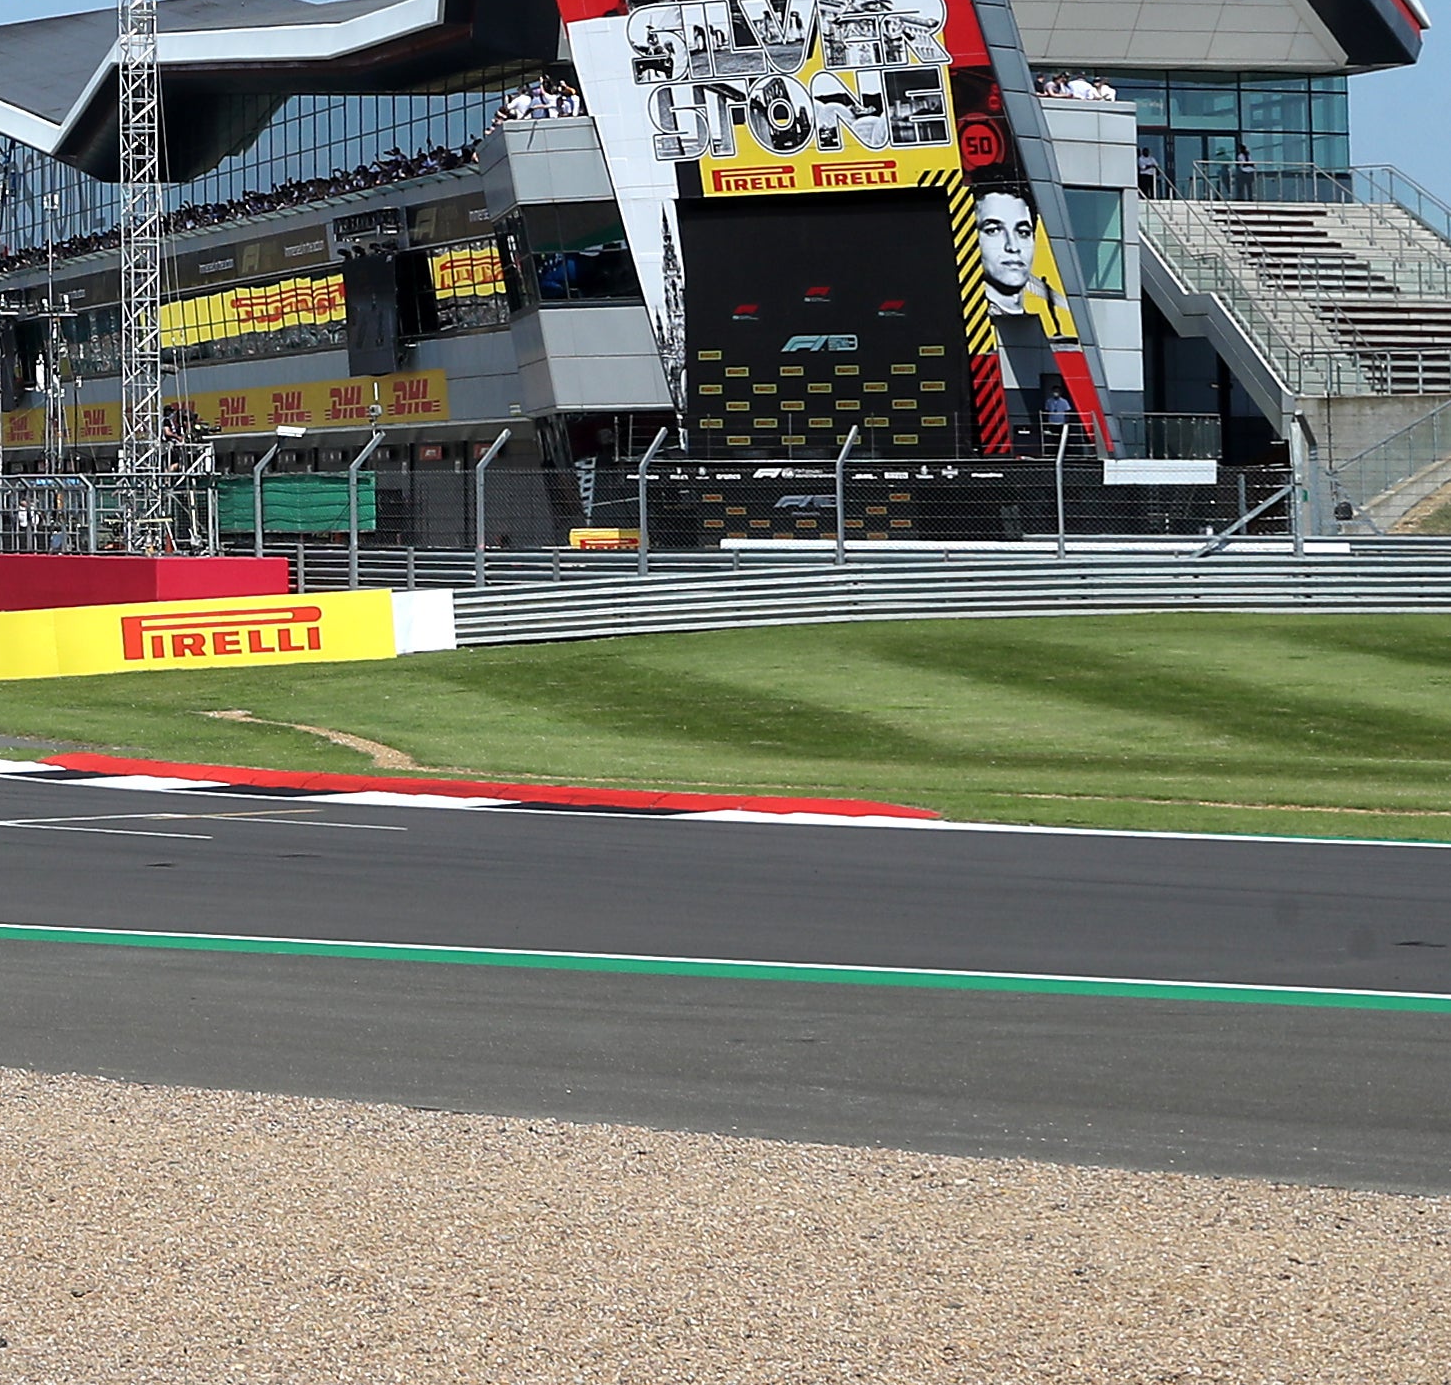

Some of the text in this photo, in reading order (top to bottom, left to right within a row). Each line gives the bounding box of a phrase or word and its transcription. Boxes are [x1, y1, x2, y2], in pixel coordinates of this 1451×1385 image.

[647, 65, 952, 162] STONE
[966, 137, 992, 154] 50
[712, 160, 898, 192] PIRELLI PIRELLI
[219, 396, 249, 426] DHL
[271, 391, 305, 422] DHL
[330, 386, 369, 418] DHL
[393, 379, 433, 414] DHL
[120, 606, 322, 660] PIRELLI
